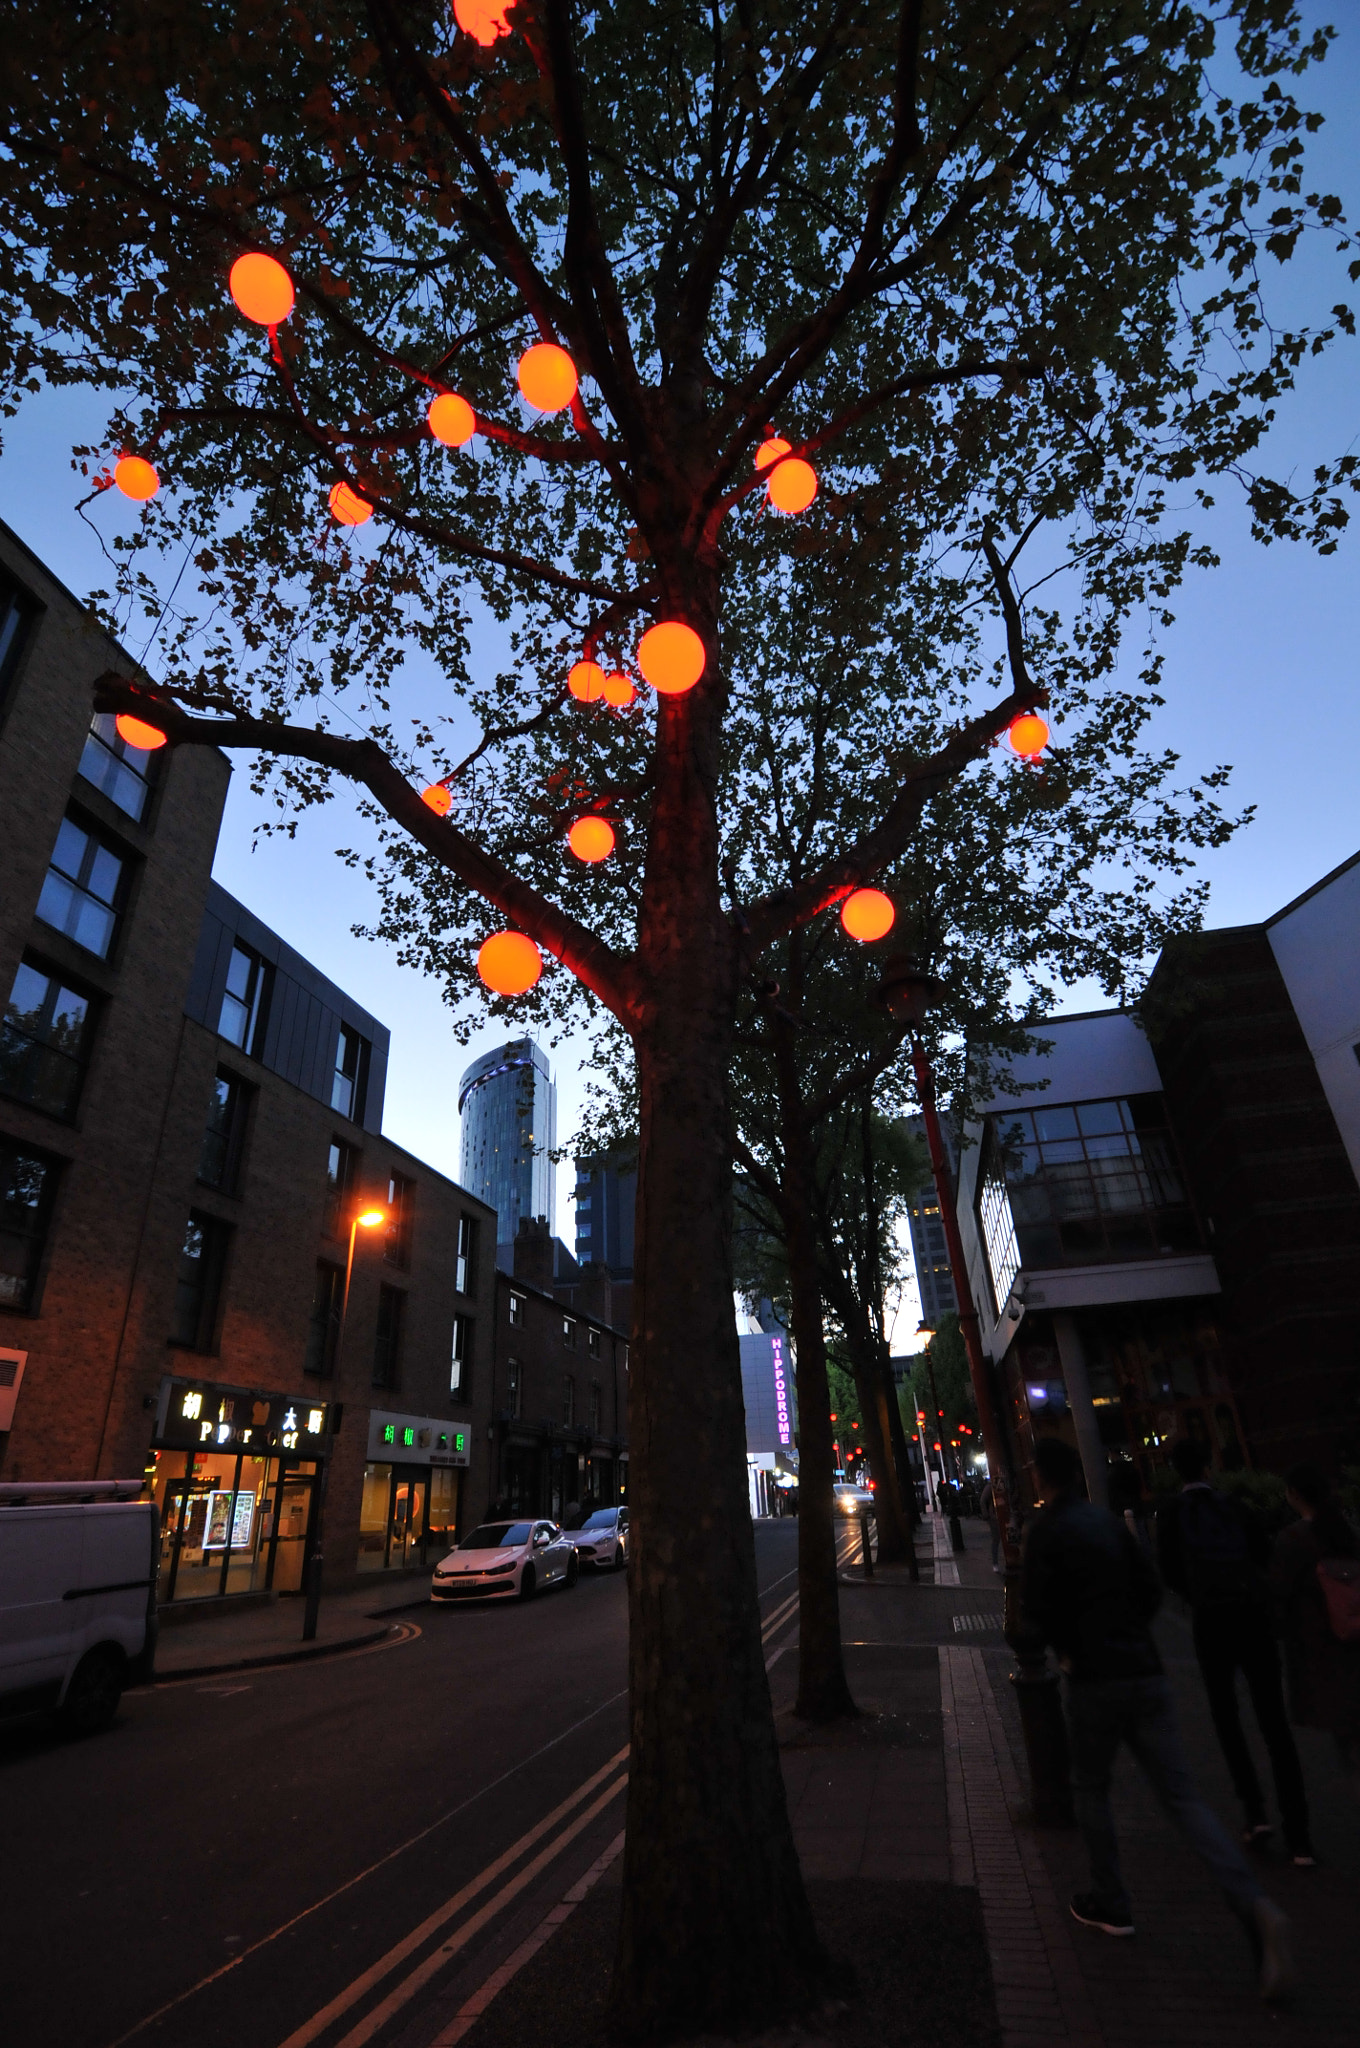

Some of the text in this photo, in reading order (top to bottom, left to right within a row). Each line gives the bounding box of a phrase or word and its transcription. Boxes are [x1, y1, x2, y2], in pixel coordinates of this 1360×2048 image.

[771, 1338, 789, 1444] HIPPODROME
[199, 1421, 299, 1450] Pepper Chef
